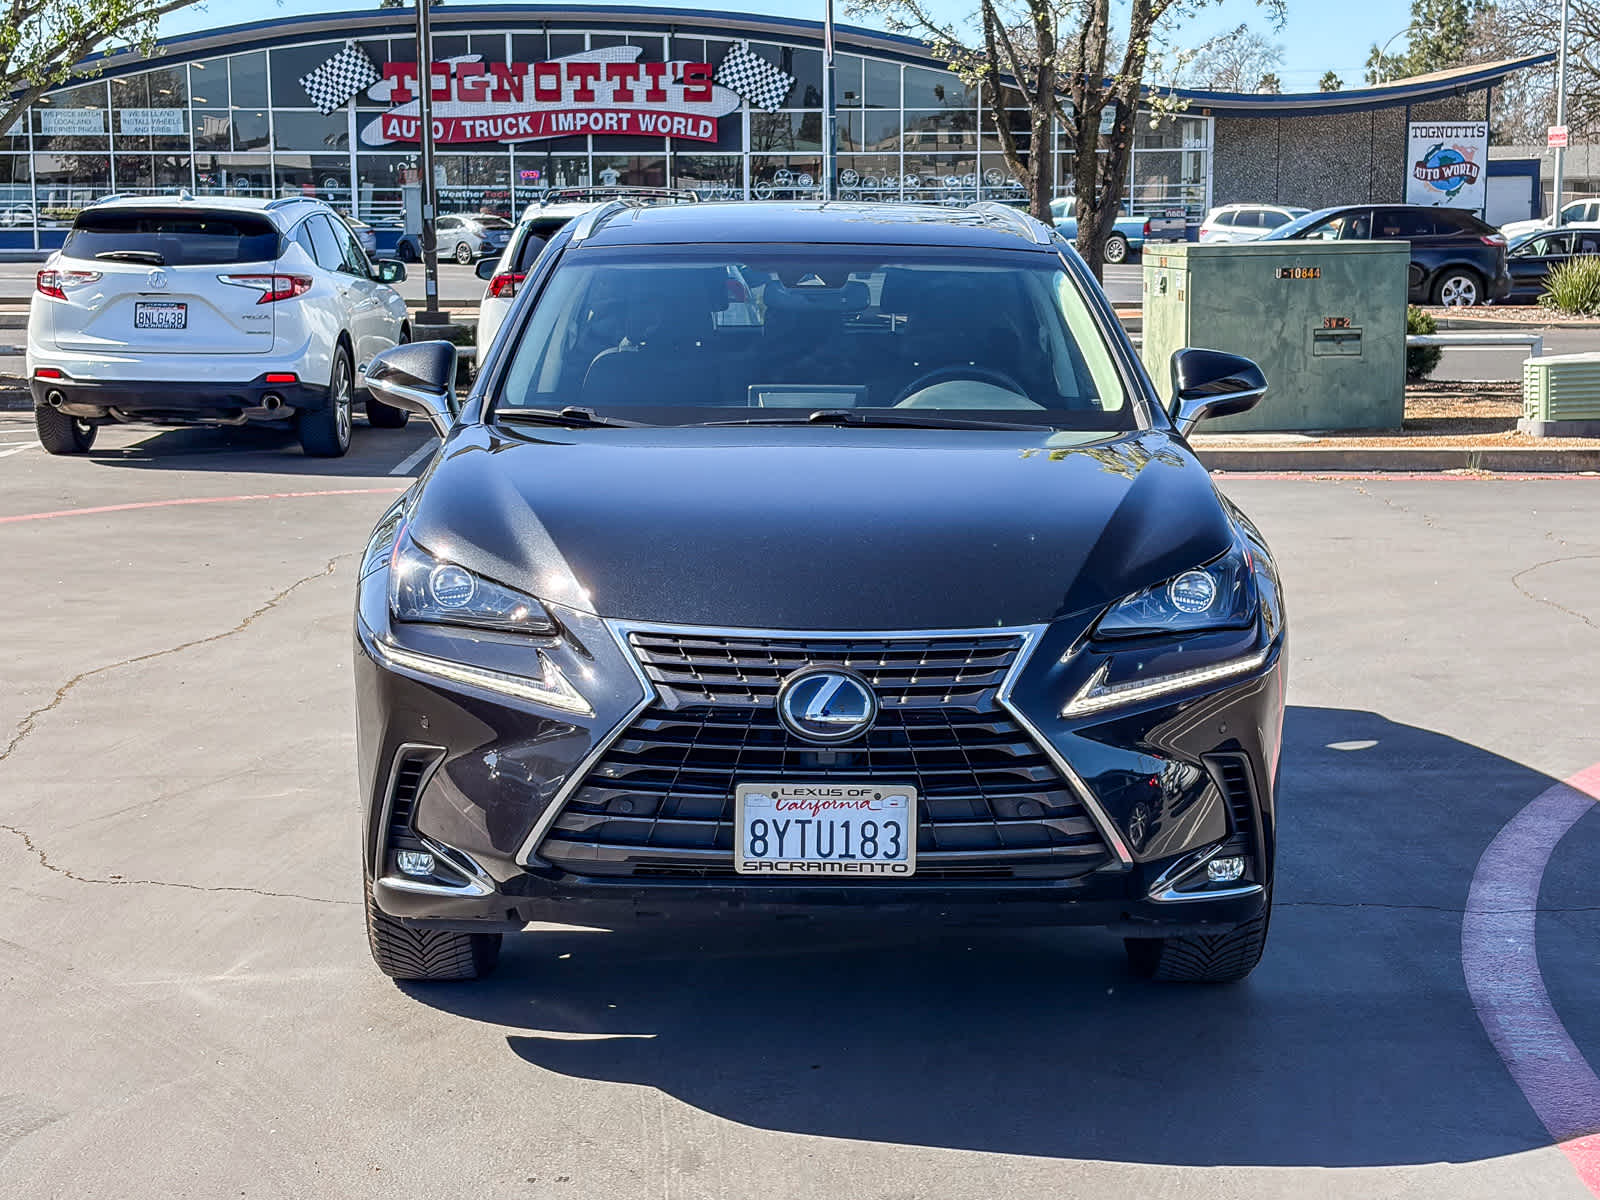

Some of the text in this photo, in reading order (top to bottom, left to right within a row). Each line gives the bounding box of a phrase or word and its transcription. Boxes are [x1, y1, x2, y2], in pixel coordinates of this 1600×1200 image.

[383, 62, 713, 102] TOGNOTTI'S
[387, 118, 444, 140] AUO
[461, 115, 533, 139] TRUCK
[551, 112, 631, 132] IMPORT
[638, 114, 713, 138] WORLD
[1411, 123, 1486, 138] TOGNOTTI'S
[1414, 163, 1478, 181] AUTO WORLD
[138, 311, 183, 325] 8NLG438
[781, 788, 873, 797] LEXUS OF
[775, 799, 882, 818] California
[750, 818, 901, 859] 8YTU183
[742, 861, 909, 873] SACRAMENTO
